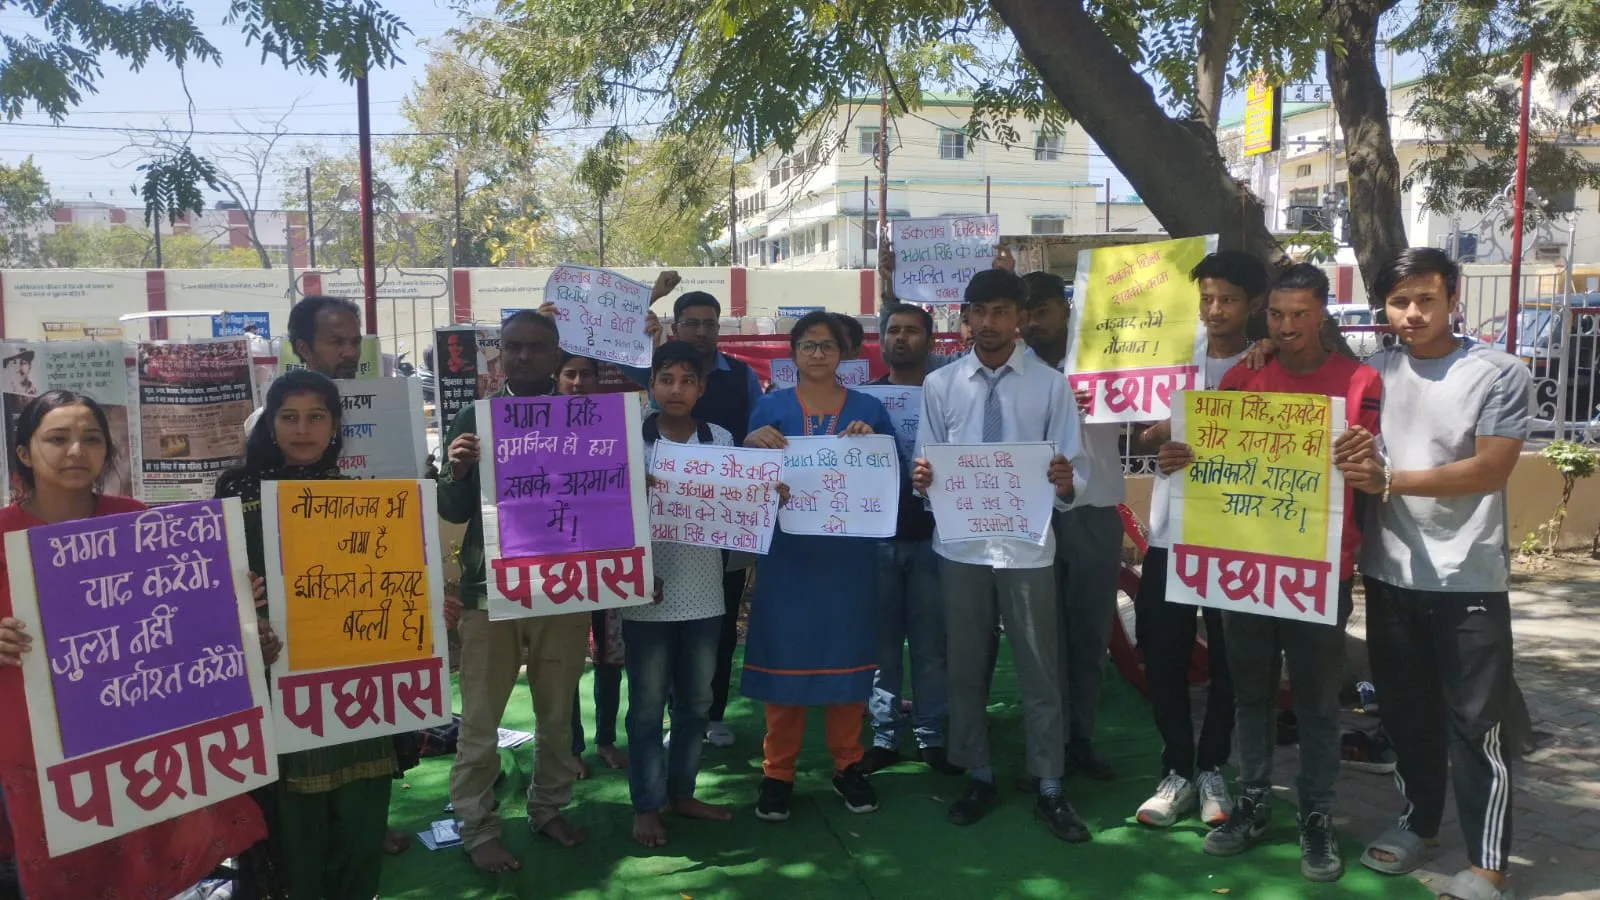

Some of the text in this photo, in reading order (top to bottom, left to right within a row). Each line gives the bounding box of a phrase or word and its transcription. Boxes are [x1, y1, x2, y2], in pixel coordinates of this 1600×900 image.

[340, 394, 376, 409] करण
[504, 397, 602, 429] भगत सिंह
[1195, 398, 1232, 418] भगत
[1277, 398, 1326, 430] सुखदेव
[342, 423, 376, 438] करण
[563, 432, 578, 455] हो
[588, 439, 618, 457] हम
[1196, 421, 1230, 449] और
[1302, 429, 1324, 457] की
[338, 455, 368, 469] करण
[655, 459, 675, 472] जब
[720, 454, 743, 478] और
[784, 455, 813, 467] भगत
[844, 448, 863, 467] की
[866, 452, 891, 467] बात
[504, 466, 550, 498] सबके
[653, 480, 669, 493] का
[747, 484, 758, 502] ही
[822, 468, 848, 492] सुनो
[1262, 466, 1322, 493] शहादत
[386, 490, 408, 519] भी
[830, 491, 850, 512] की
[861, 498, 882, 512] राह
[1005, 492, 1025, 511] के
[1222, 493, 1266, 517] अमर
[48, 526, 118, 567] भगत
[337, 525, 388, 559] जागा है
[652, 524, 678, 539] भगत
[711, 533, 728, 545] बन
[80, 571, 134, 608] याद
[294, 564, 355, 600] इतिहास
[359, 563, 376, 599] ने
[491, 546, 645, 609] पछास
[1172, 543, 1332, 616] पछास
[343, 599, 392, 641] बदली
[52, 604, 178, 681] जुल्म नहीं
[100, 645, 245, 707] बर्दाश्त करेंगे
[277, 657, 443, 737] पछास
[46, 705, 268, 828] पछास
